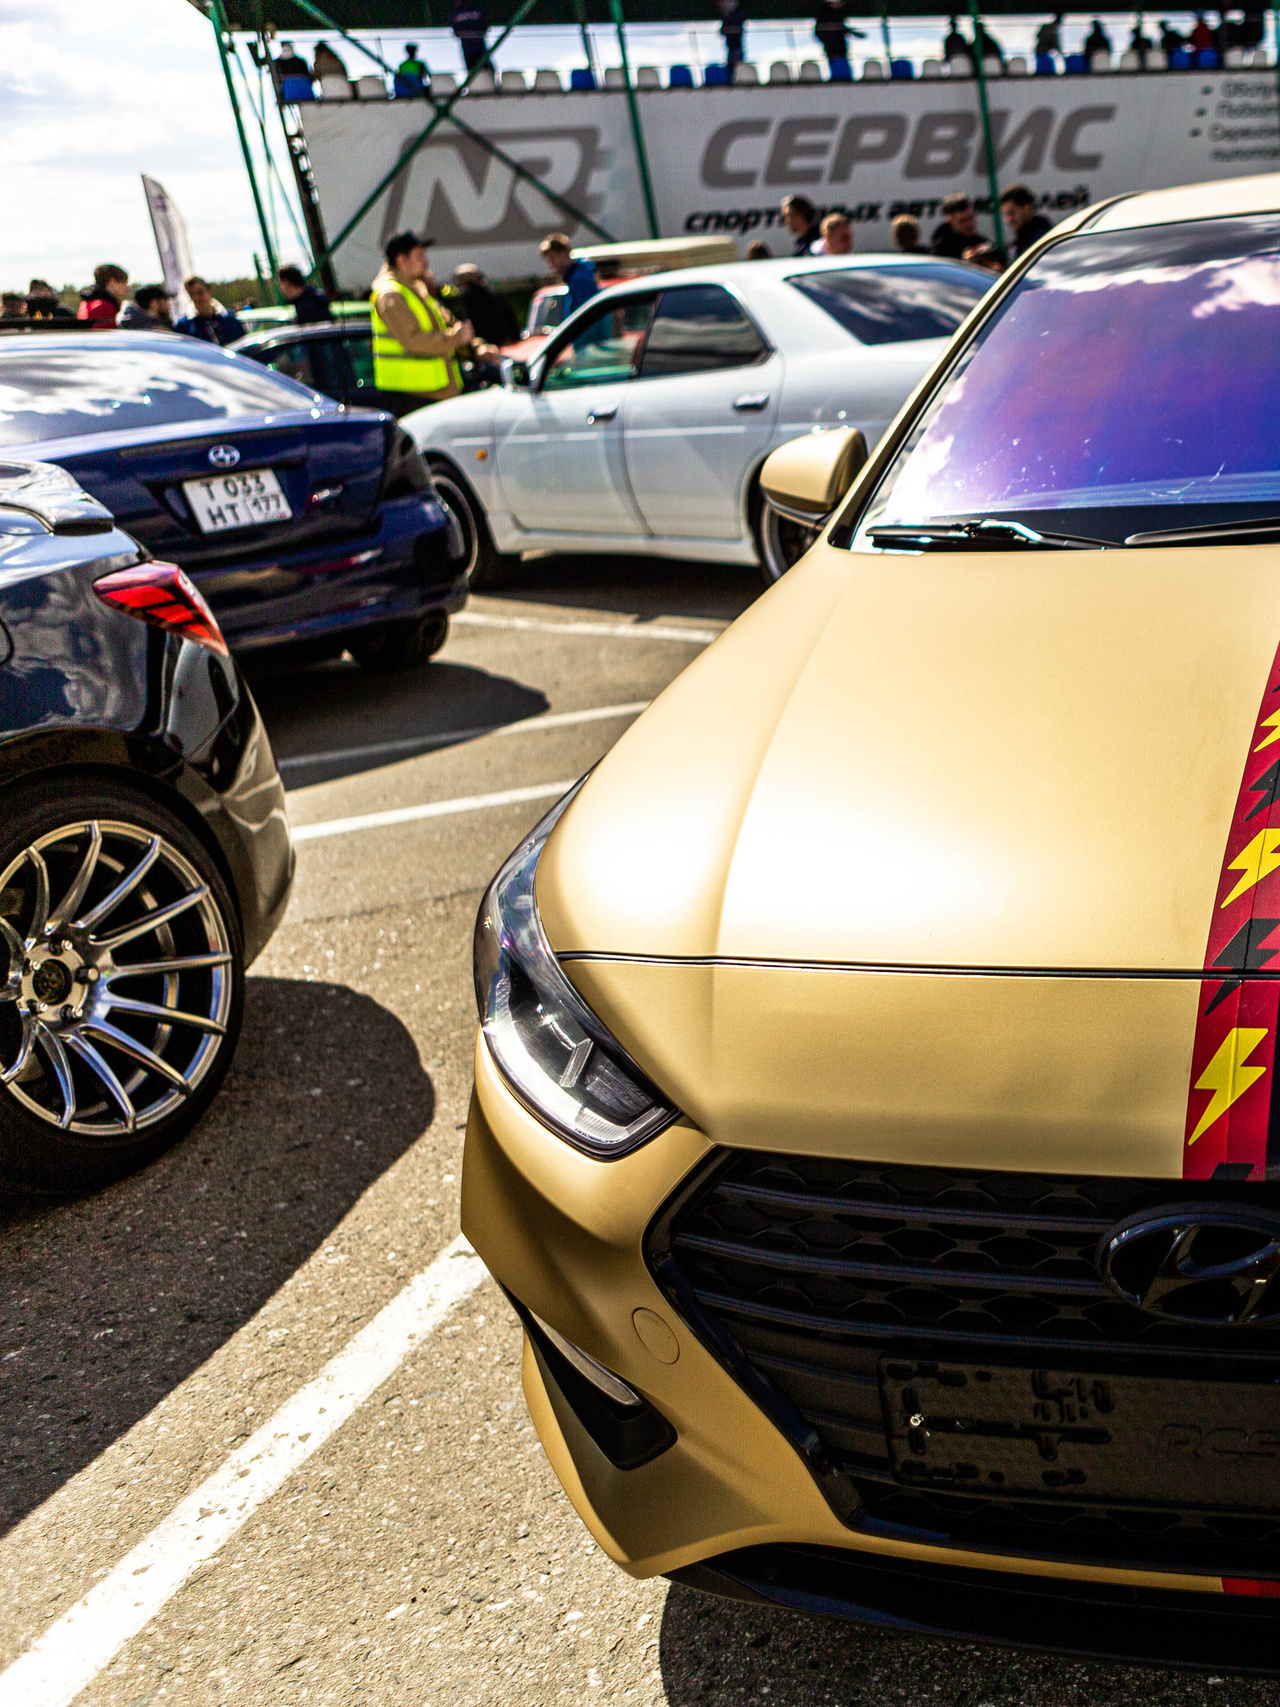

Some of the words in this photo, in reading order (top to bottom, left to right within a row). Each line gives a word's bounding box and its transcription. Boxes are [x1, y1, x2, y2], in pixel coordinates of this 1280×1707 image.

[701, 105, 1118, 189] СЕРВИС
[684, 202, 881, 236] спортных
[223, 473, 266, 498] 033
[252, 493, 281, 512] 177
